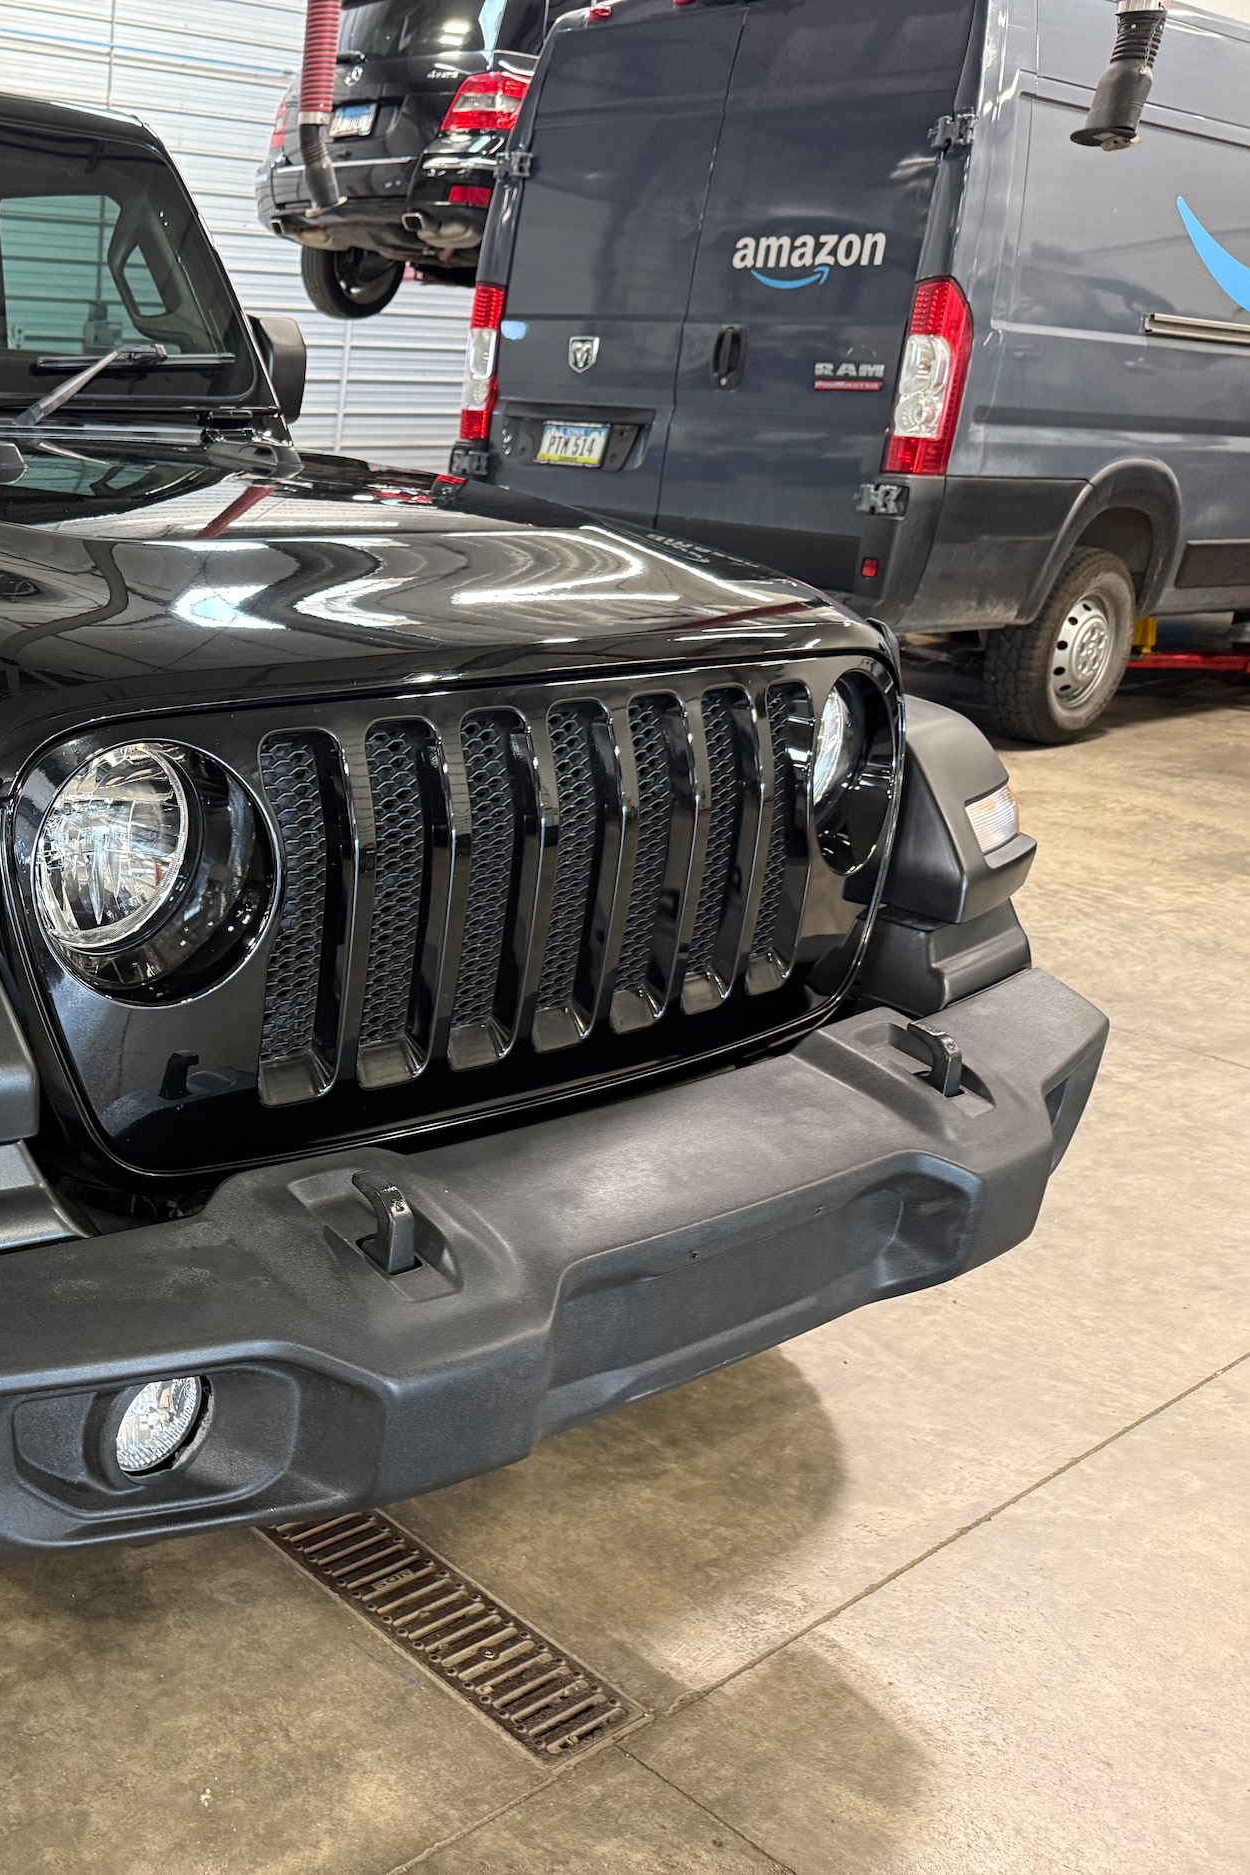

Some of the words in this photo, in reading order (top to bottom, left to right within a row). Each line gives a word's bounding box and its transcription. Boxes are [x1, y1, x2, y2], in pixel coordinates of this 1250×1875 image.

[732, 232, 887, 270] amazon
[814, 362, 886, 378] RAM
[571, 437, 596, 458] 514
[373, 1569, 412, 1589] NDS
